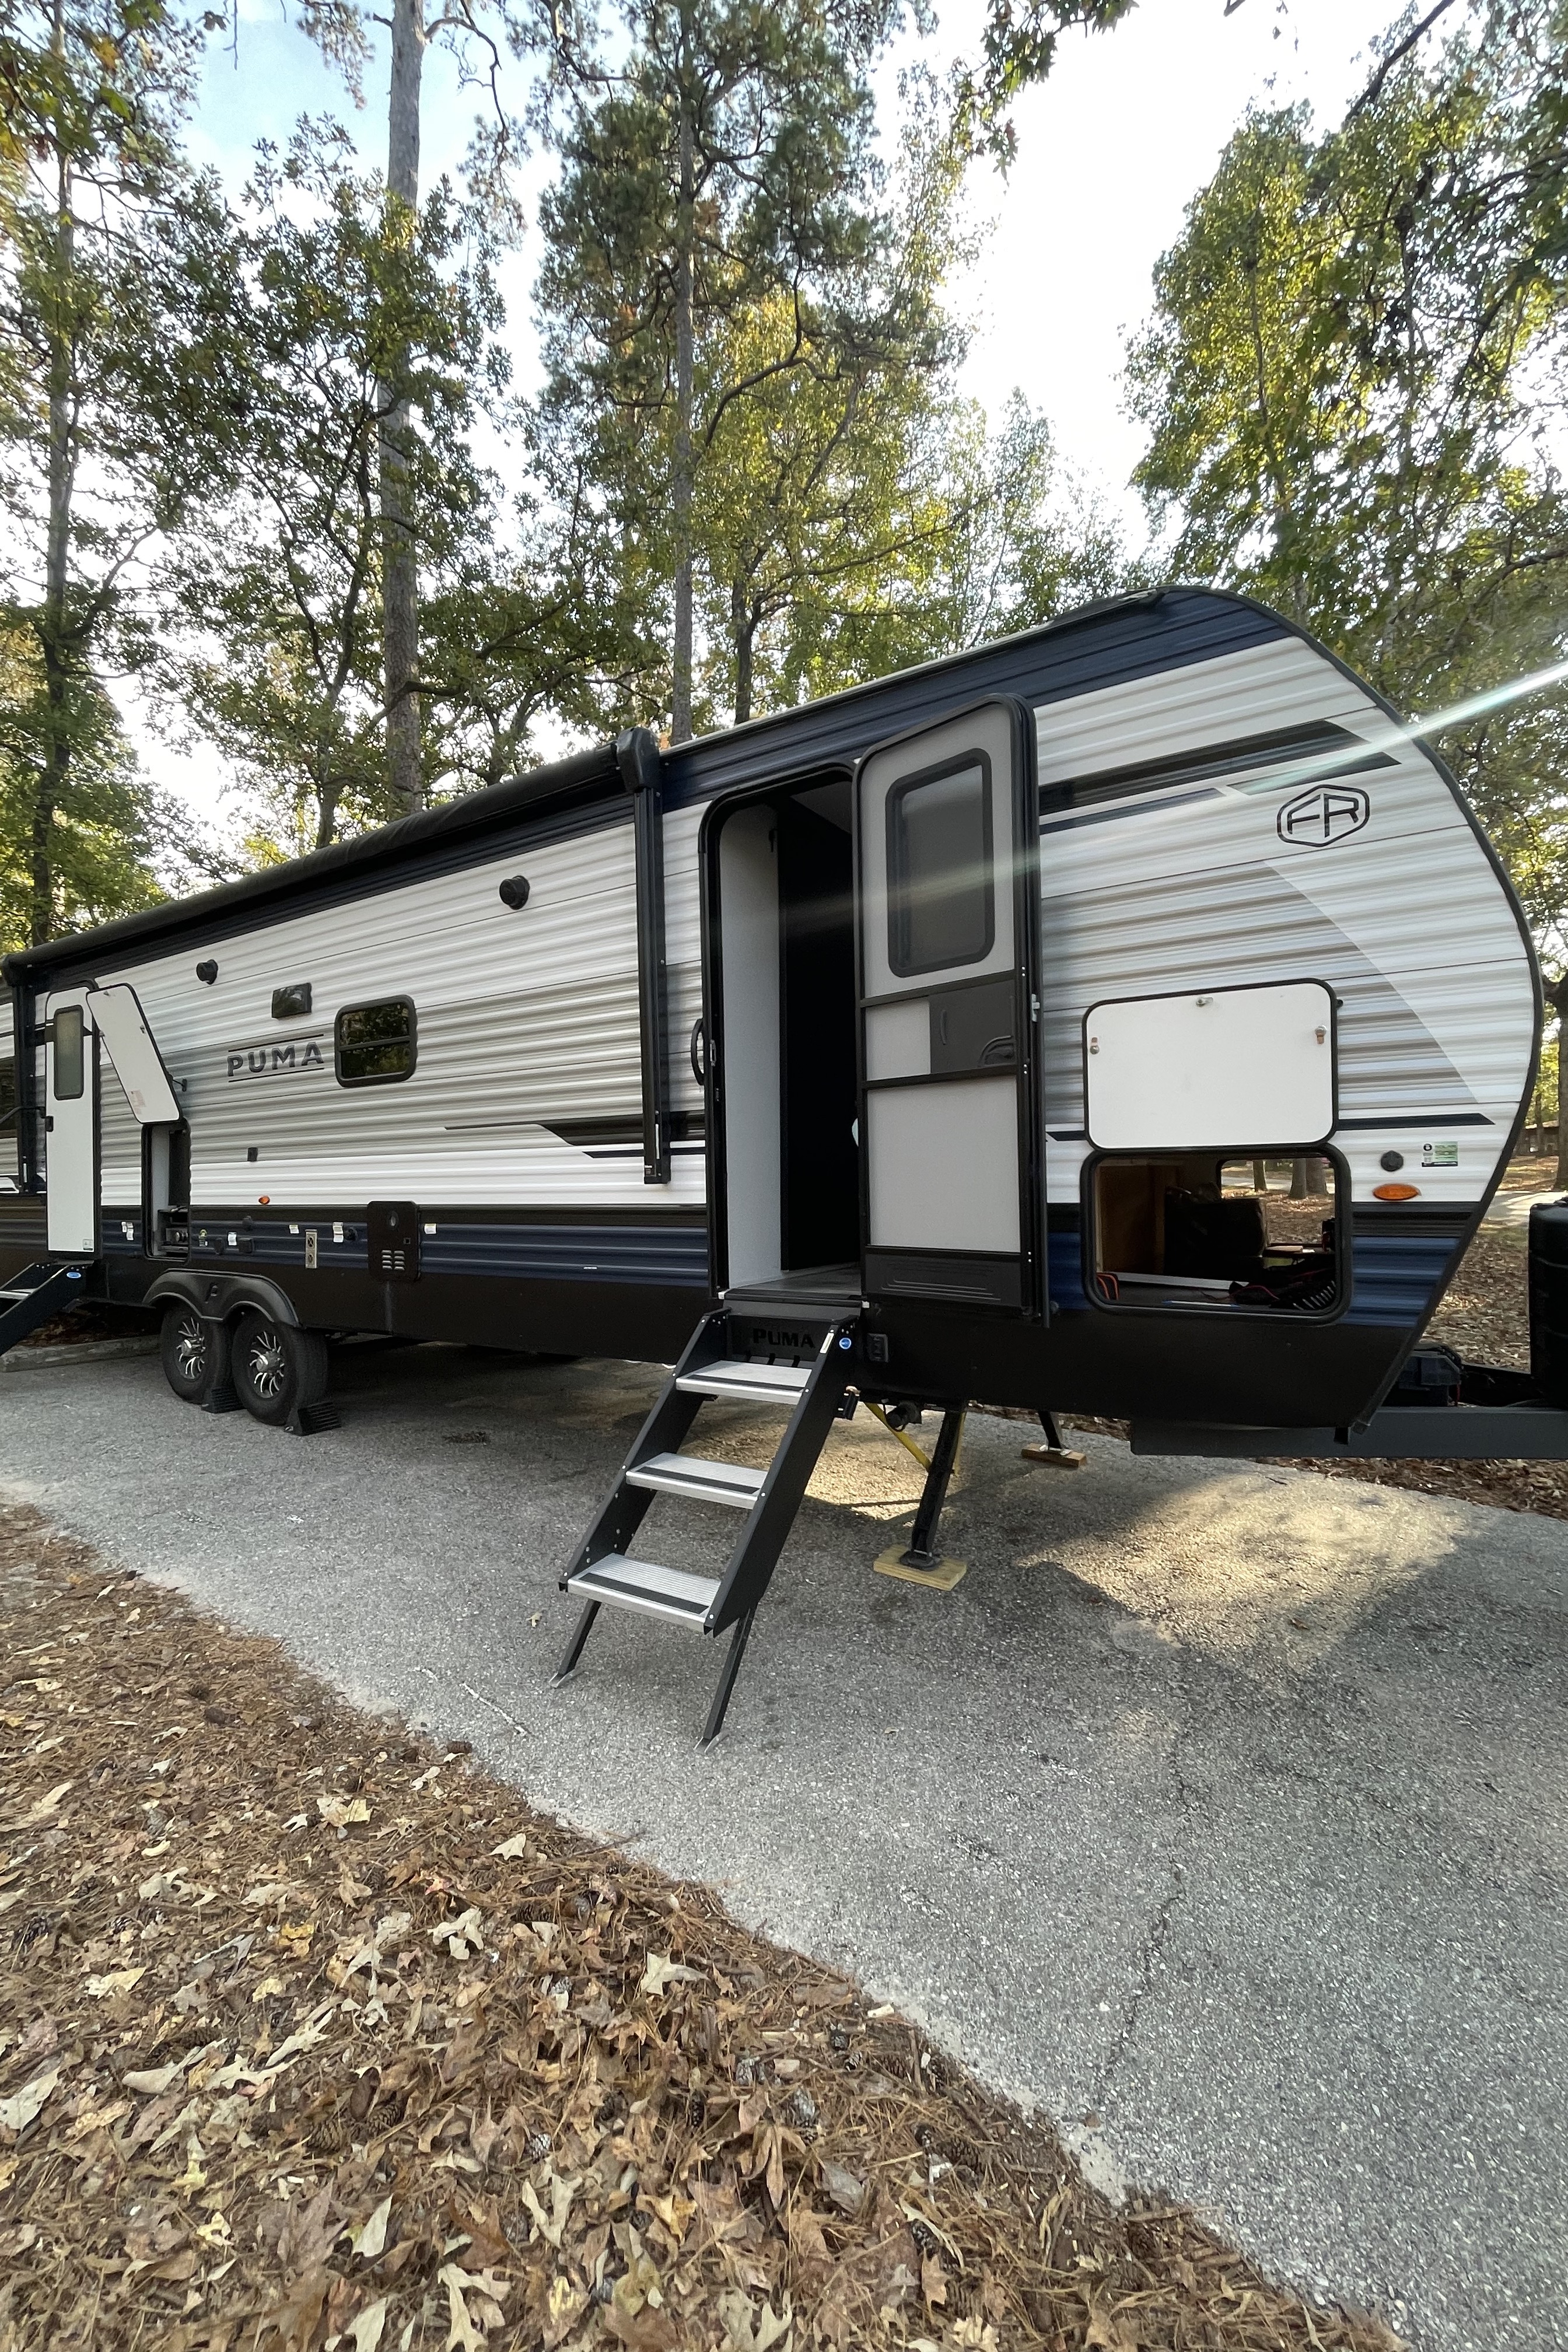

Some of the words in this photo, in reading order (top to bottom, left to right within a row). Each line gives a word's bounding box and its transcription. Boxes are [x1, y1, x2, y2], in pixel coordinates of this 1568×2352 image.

[1287, 793, 1359, 838] FR
[227, 1041, 324, 1077] PUMA
[753, 1328, 816, 1348] PUMA
